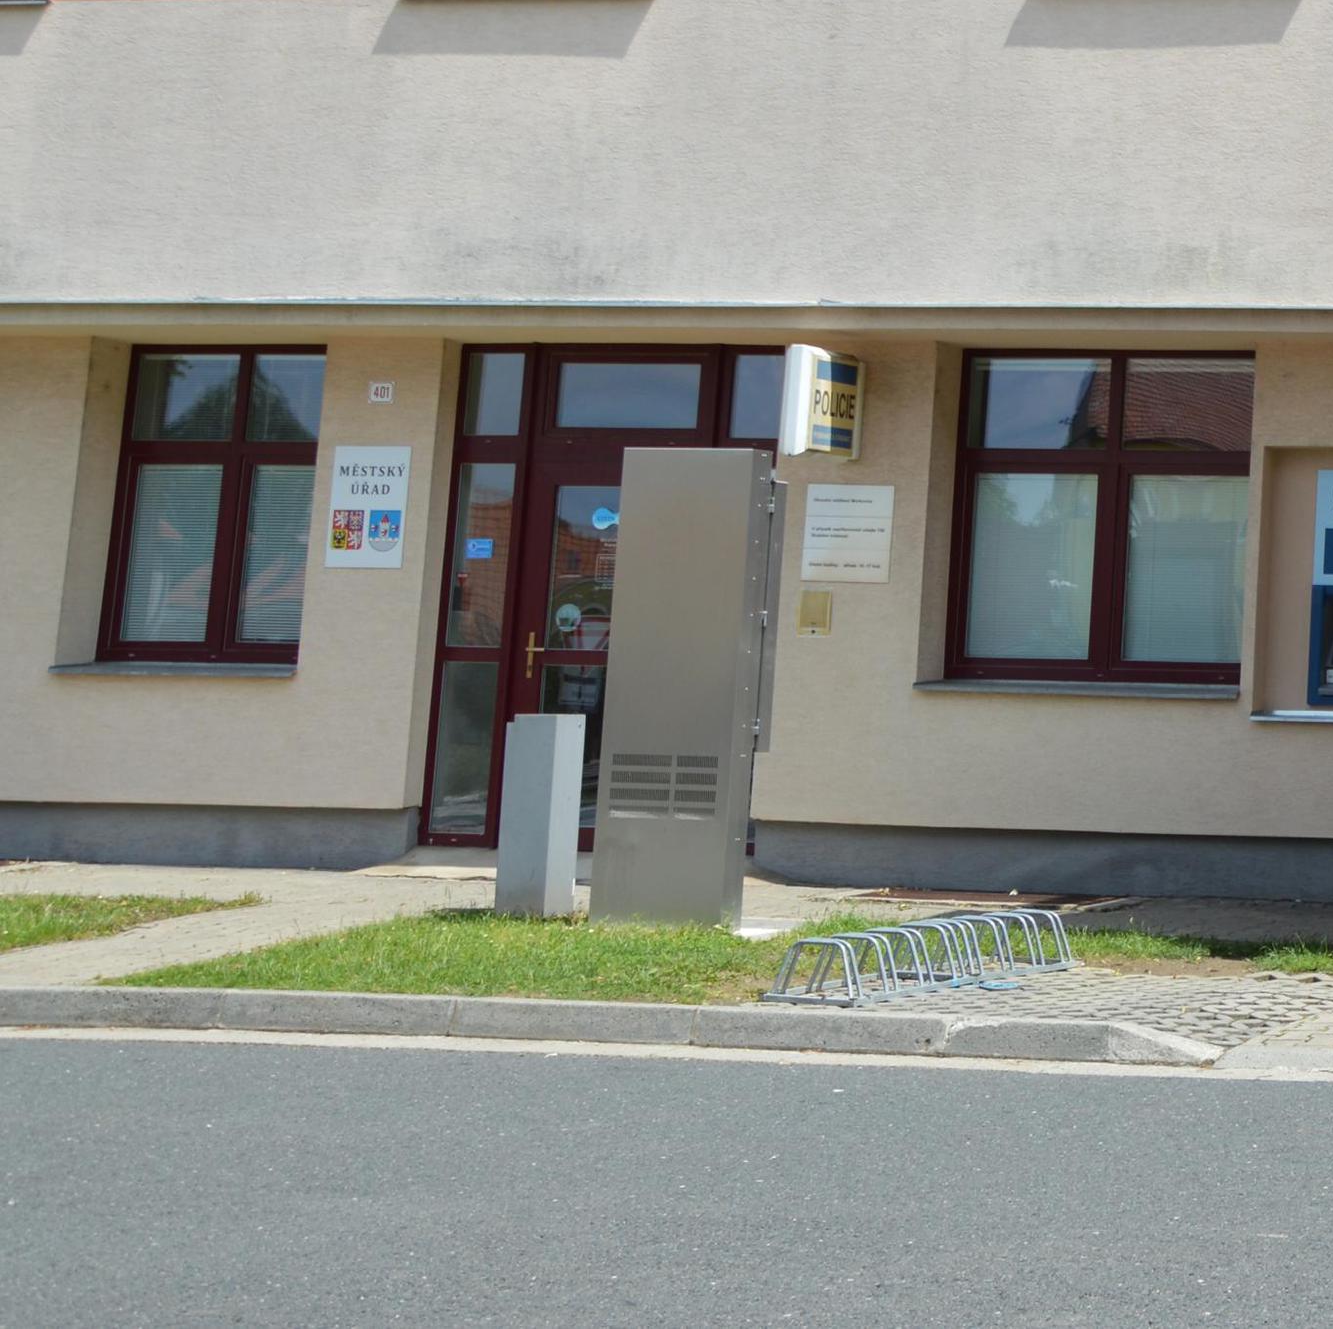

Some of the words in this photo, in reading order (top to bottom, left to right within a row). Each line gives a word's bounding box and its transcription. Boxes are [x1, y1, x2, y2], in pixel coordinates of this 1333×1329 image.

[373, 386, 390, 399] 401
[813, 389, 856, 419] POLICIE
[339, 463, 406, 478] MĚSTSKÝ
[351, 481, 391, 496] ÚŘAD
